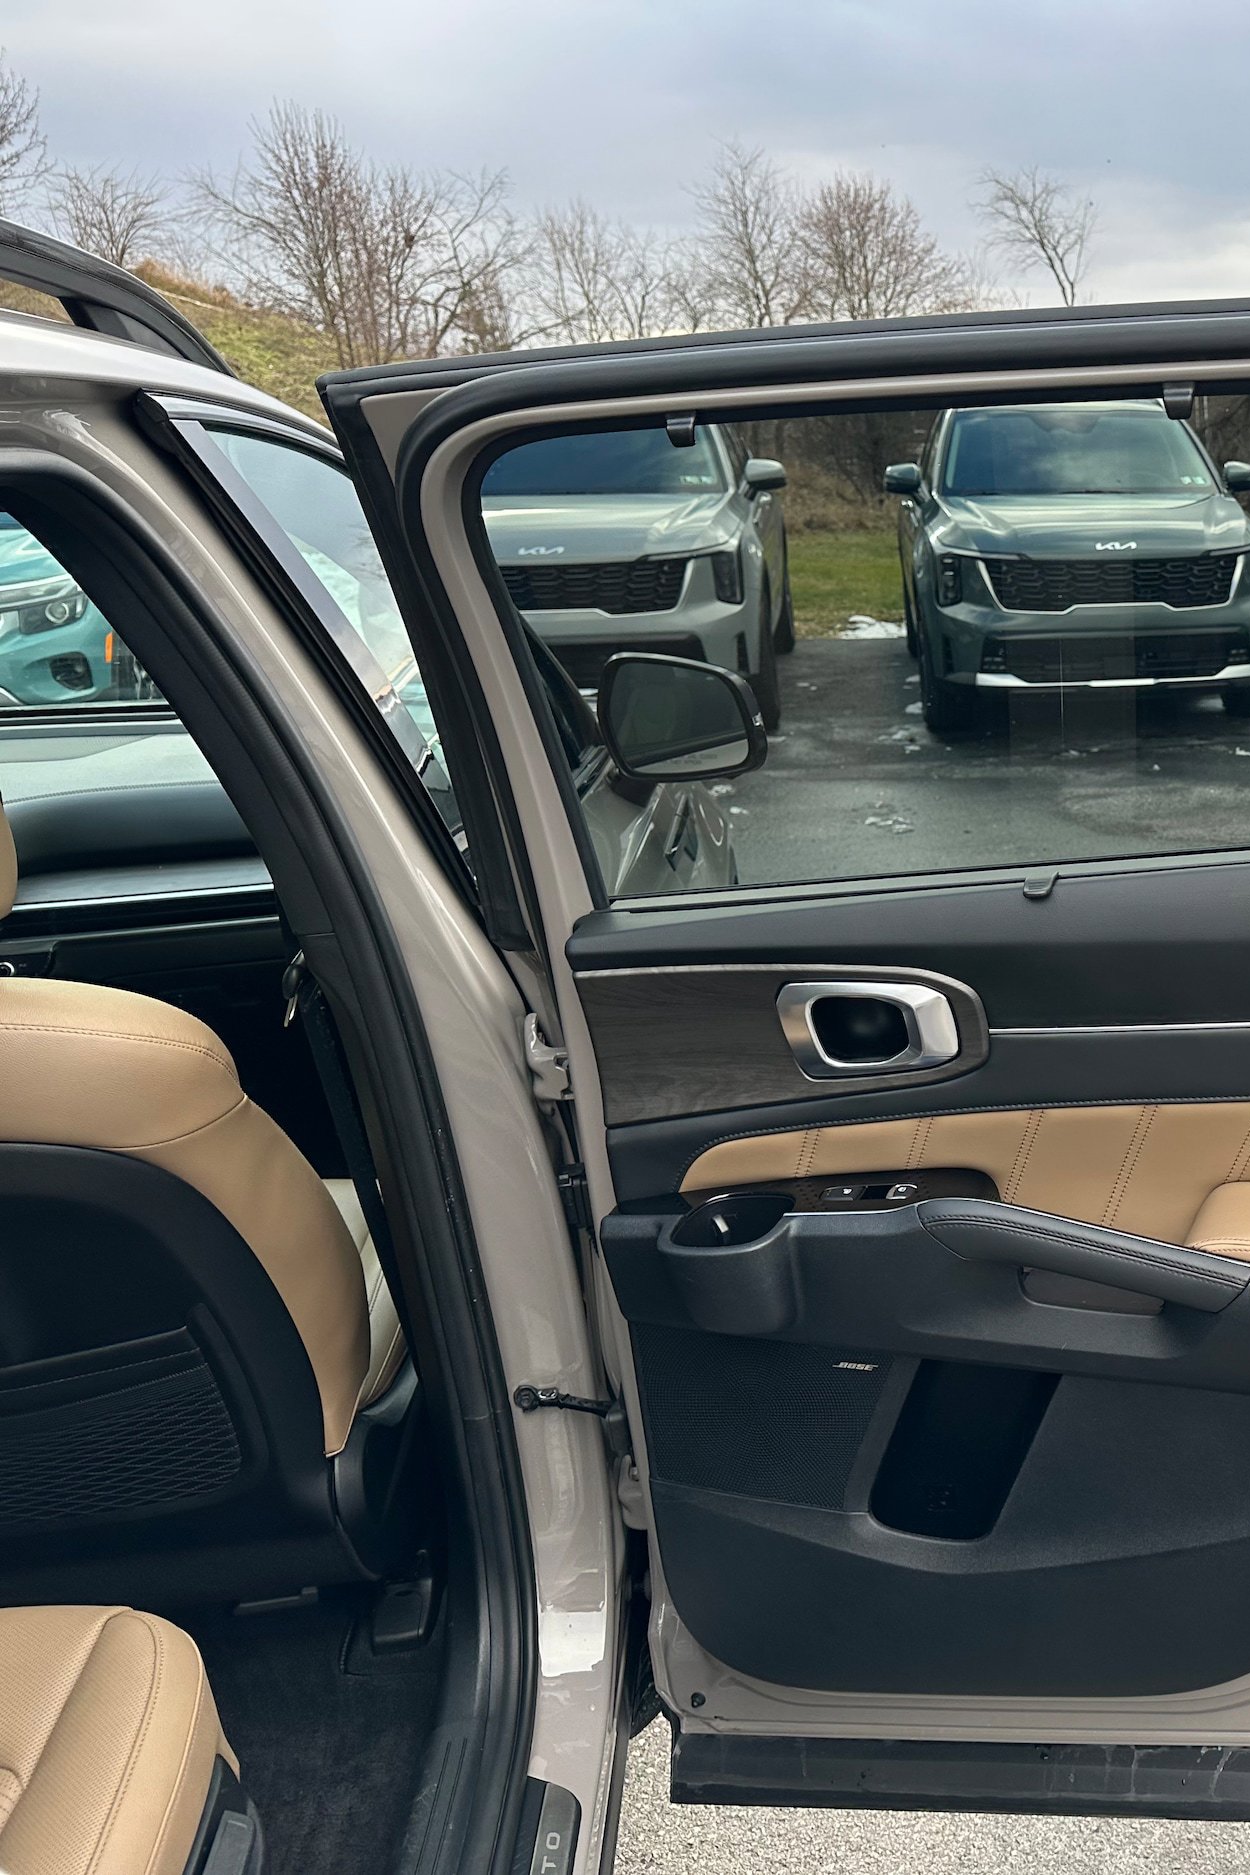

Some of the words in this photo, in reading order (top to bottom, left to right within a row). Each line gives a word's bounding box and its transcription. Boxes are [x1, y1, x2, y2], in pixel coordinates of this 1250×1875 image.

[518, 546, 565, 555] KIA
[1095, 541, 1137, 551] KIA
[832, 1361, 879, 1371] BOSE
